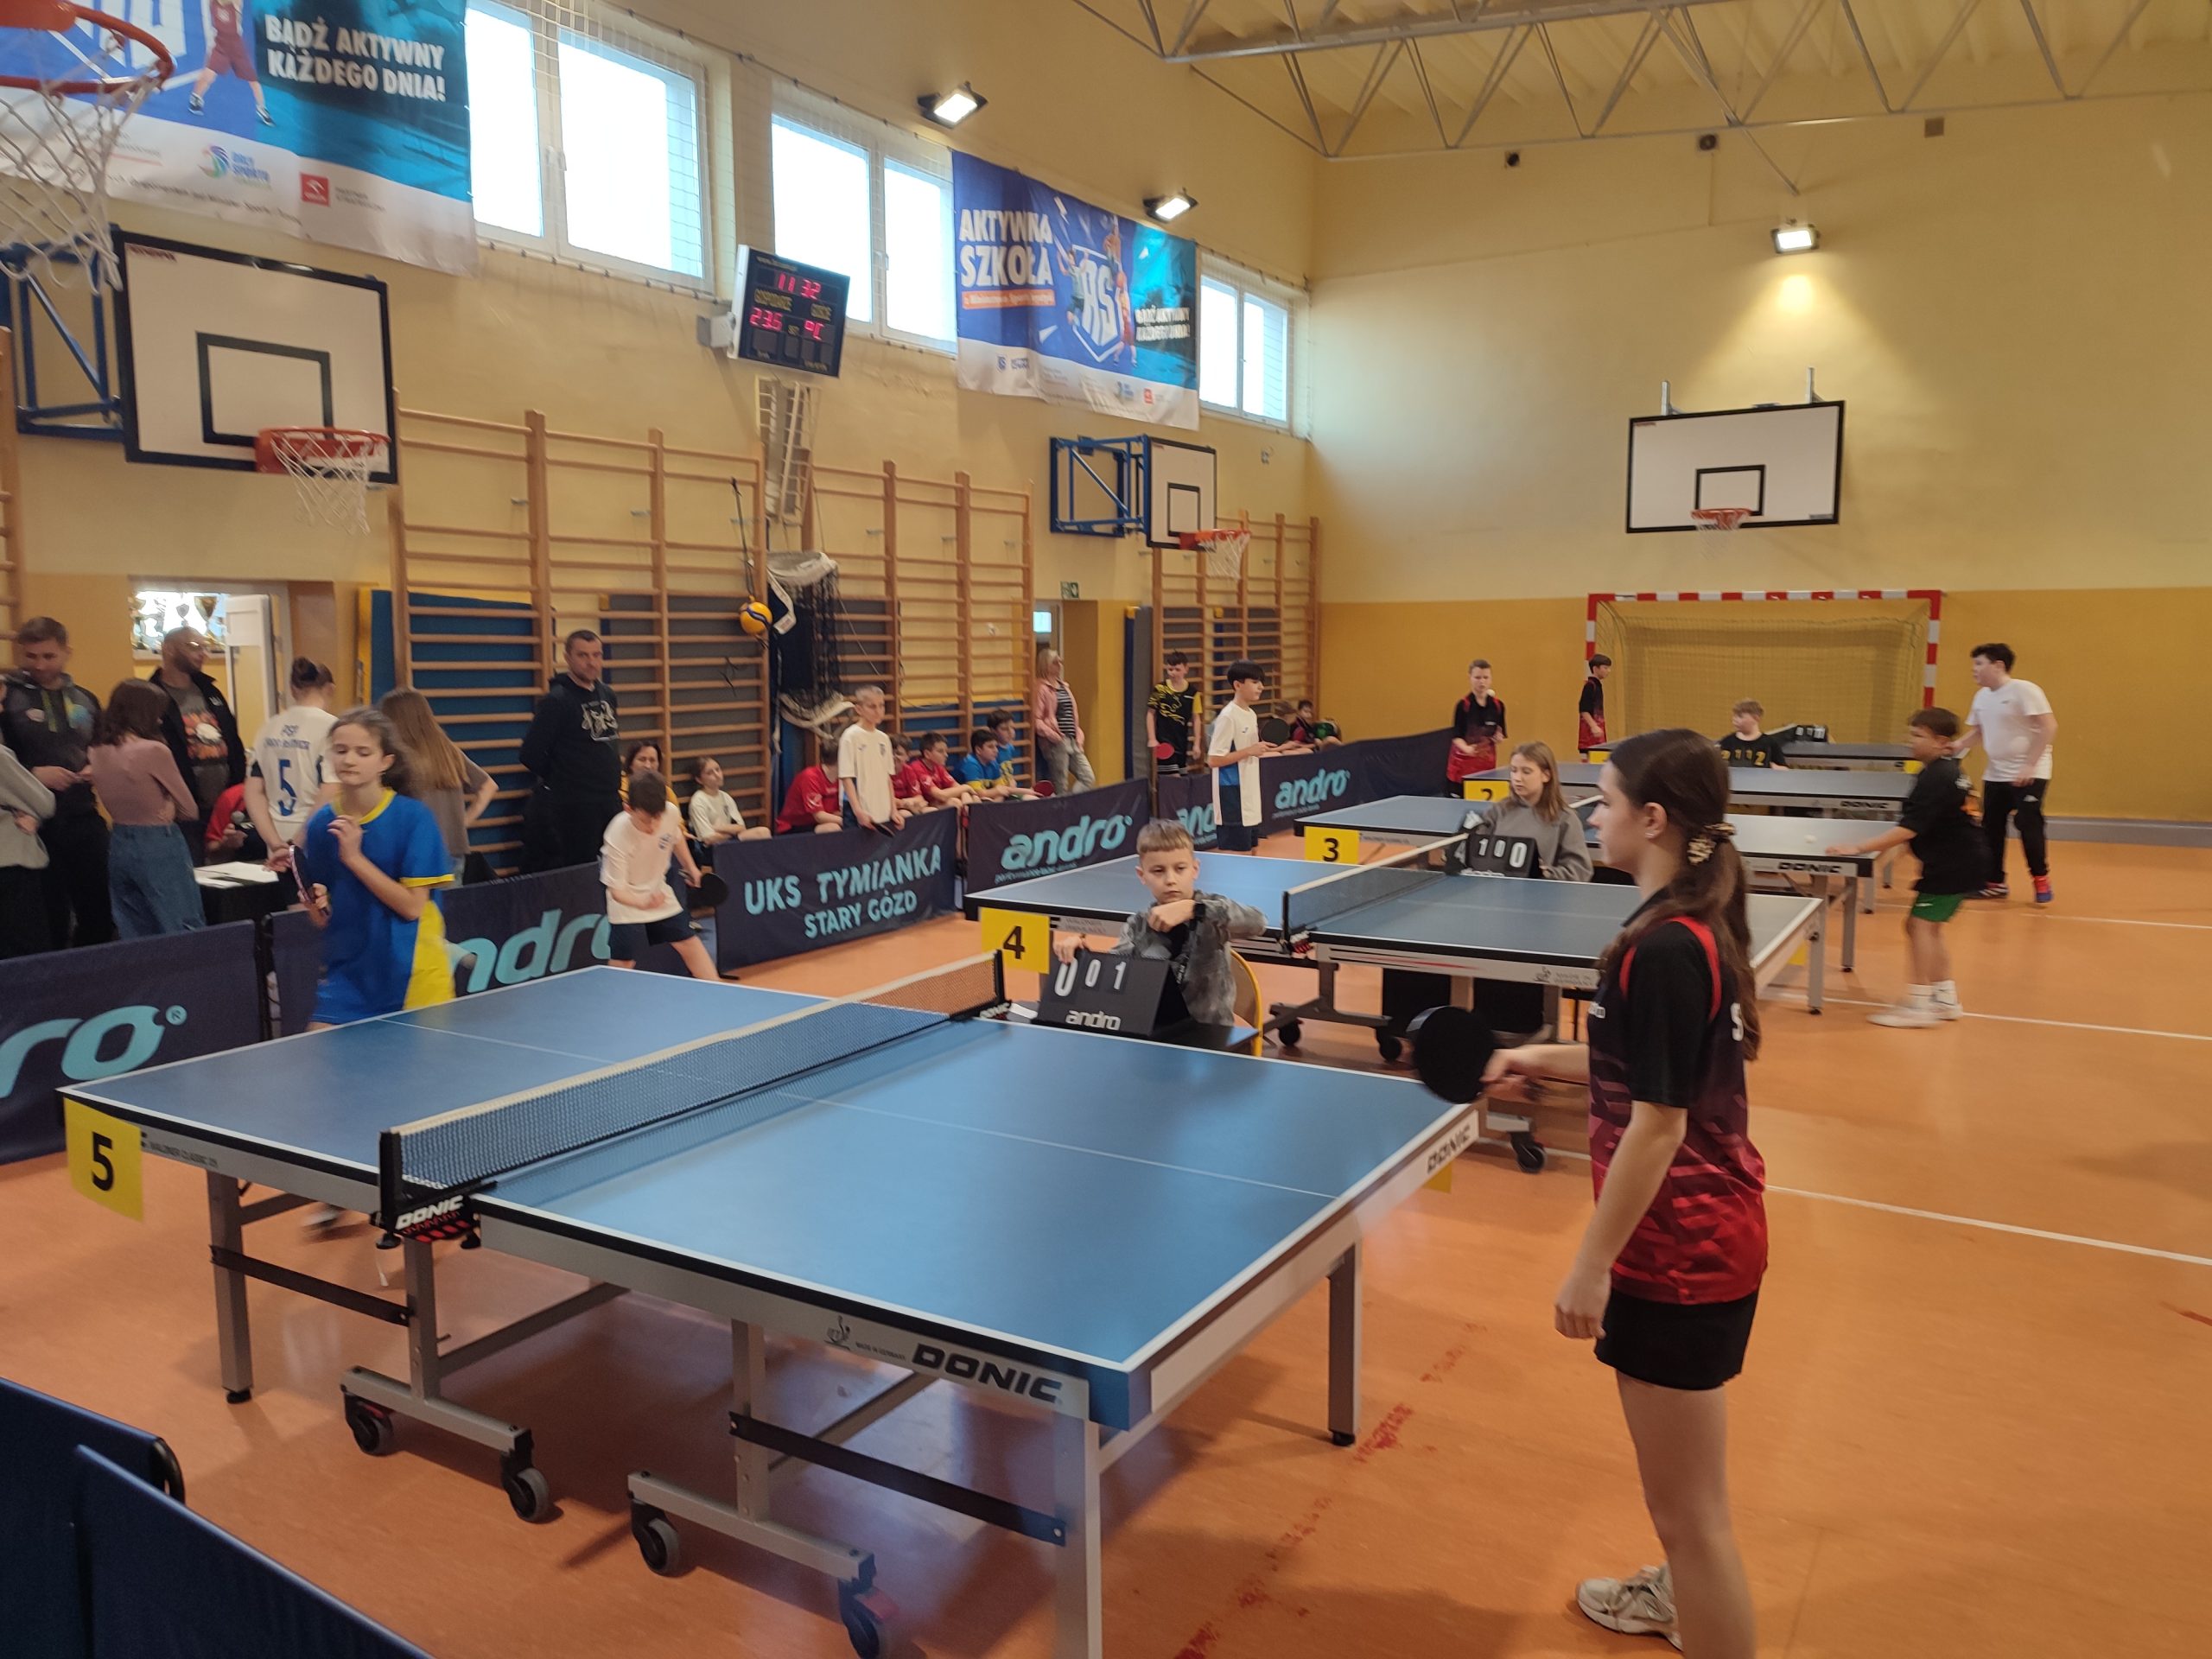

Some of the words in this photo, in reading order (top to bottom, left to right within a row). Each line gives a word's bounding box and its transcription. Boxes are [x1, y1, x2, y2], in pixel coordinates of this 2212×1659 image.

[336, 27, 445, 71] AKTYWNY
[382, 68, 447, 103] DNIA!
[959, 208, 1053, 244] AKTYWNA
[960, 245, 1053, 287] SZKOŁA
[278, 759, 297, 816] 5
[1274, 768, 1348, 810] andro
[1001, 815, 1132, 870] andro
[1322, 837, 1339, 862] 3
[1510, 842, 1528, 868] 0
[744, 875, 802, 916] UKS
[817, 844, 942, 904] TYMIANKA
[804, 904, 862, 939] STARY
[867, 890, 918, 923] GÓZD
[1003, 925, 1026, 960] 4
[1084, 959, 1102, 988] 0
[1113, 961, 1127, 990] 1
[1065, 1009, 1122, 1031] andro
[92, 1131, 114, 1192] 5
[395, 1194, 465, 1230] DONIC
[912, 1343, 1063, 1404] DONIC
